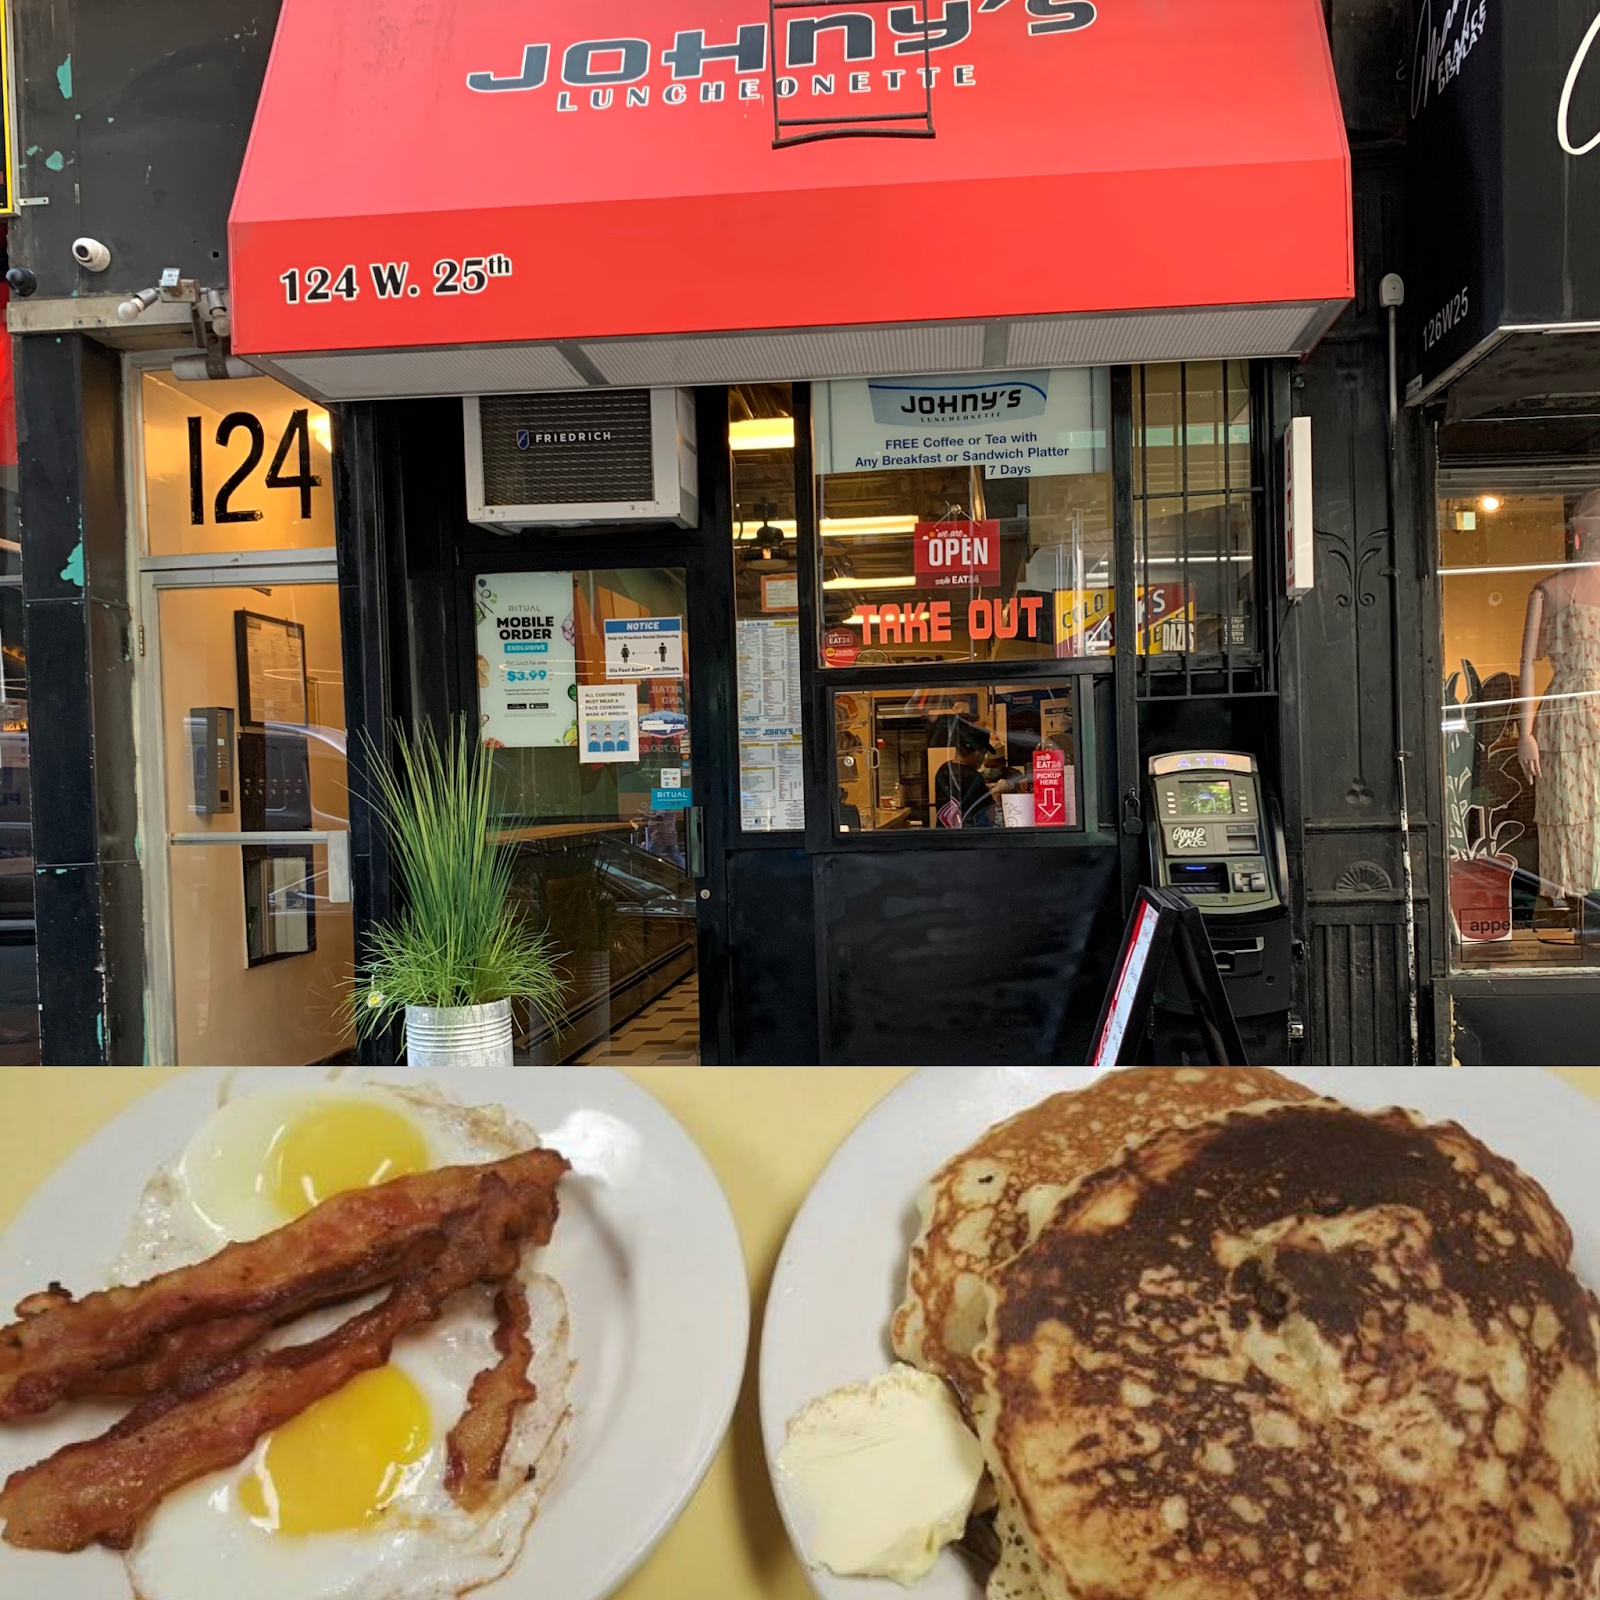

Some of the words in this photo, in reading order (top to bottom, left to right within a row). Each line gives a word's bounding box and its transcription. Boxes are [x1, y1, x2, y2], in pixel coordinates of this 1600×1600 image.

[556, 64, 977, 112] LUNCHEONETTE
[279, 267, 360, 305] 124
[370, 262, 420, 299] W.
[432, 253, 513, 295] 25th
[1422, 285, 1470, 353] 126W25
[920, 411, 1002, 424] LUNCHEONETTE
[535, 431, 613, 444] FRIEDRICH
[884, 438, 919, 450] FREE
[923, 436, 964, 449] Coffee
[968, 437, 982, 446] or
[985, 433, 1007, 445] Tea
[1010, 431, 1038, 444] with
[855, 456, 879, 469] Any
[882, 452, 941, 466] Breakfast
[945, 453, 959, 463] or
[962, 448, 1024, 462] Sandwich
[1027, 446, 1070, 459] Platter
[186, 408, 323, 526] 124
[988, 465, 997, 476] 7
[1000, 464, 1032, 476] Days
[928, 536, 989, 567] OPEN
[951, 574, 980, 585] EAT24
[508, 605, 542, 613] RITUAL
[496, 616, 555, 628] MOBILE
[626, 621, 660, 631] NOTICE
[854, 600, 953, 646] TAKE
[967, 596, 1044, 640] OUT
[499, 628, 553, 641] ORDER
[828, 636, 851, 645] EAT24
[507, 670, 548, 683] $3.99
[1177, 757, 1227, 767] ATM
[1003, 802, 1022, 815] TIPS
